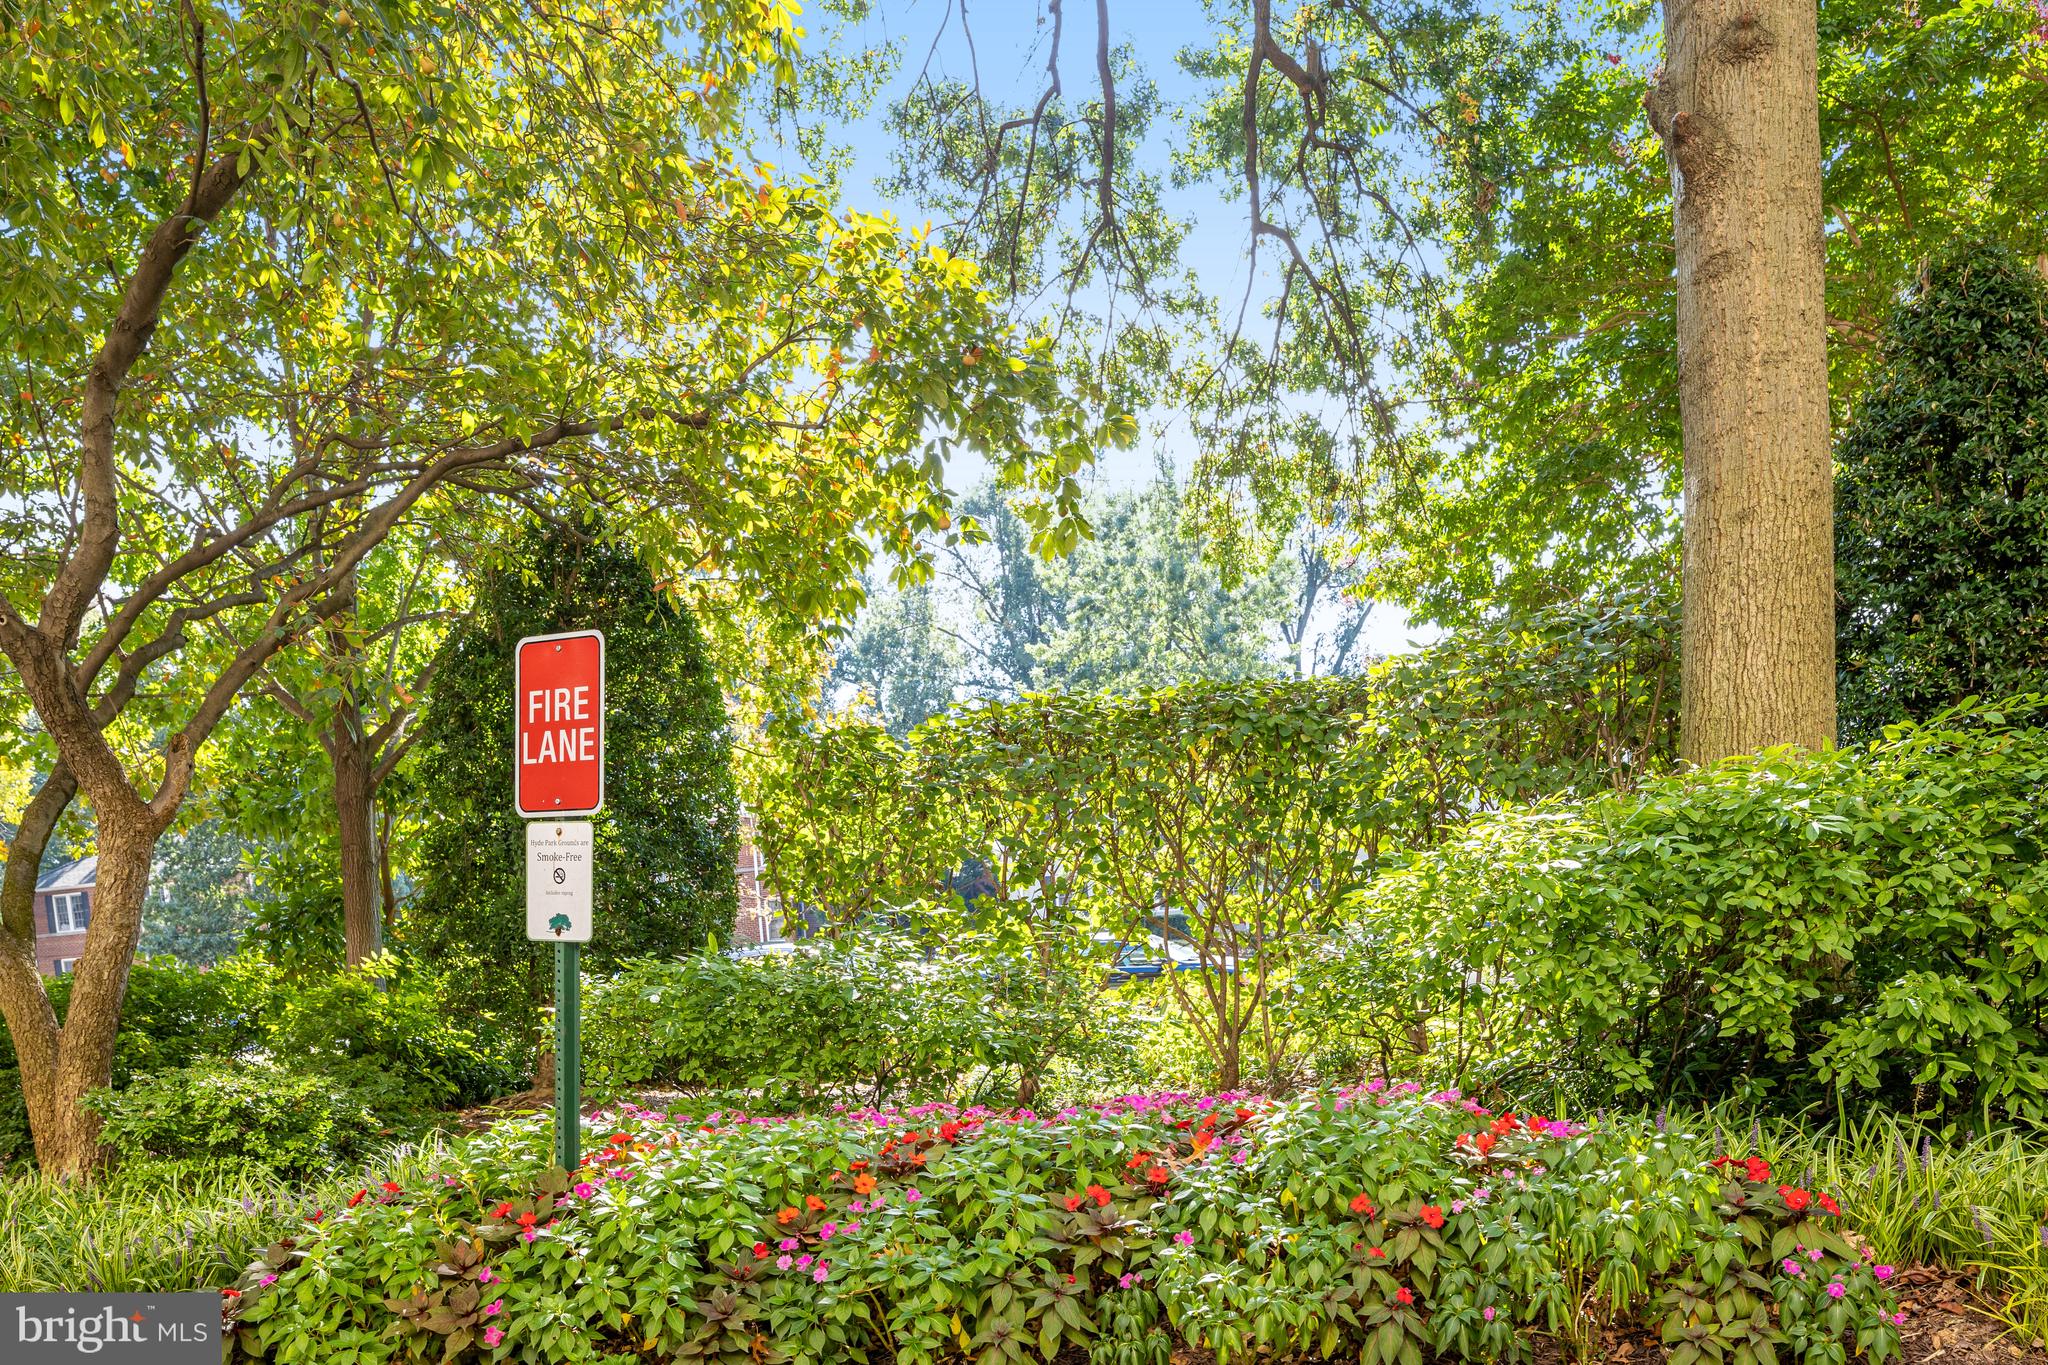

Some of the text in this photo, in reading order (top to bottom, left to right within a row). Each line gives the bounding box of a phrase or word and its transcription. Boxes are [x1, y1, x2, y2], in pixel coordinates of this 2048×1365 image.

[529, 686, 589, 724] FIRE
[523, 727, 595, 765] LANE
[537, 852, 582, 862] Smoke-Free
